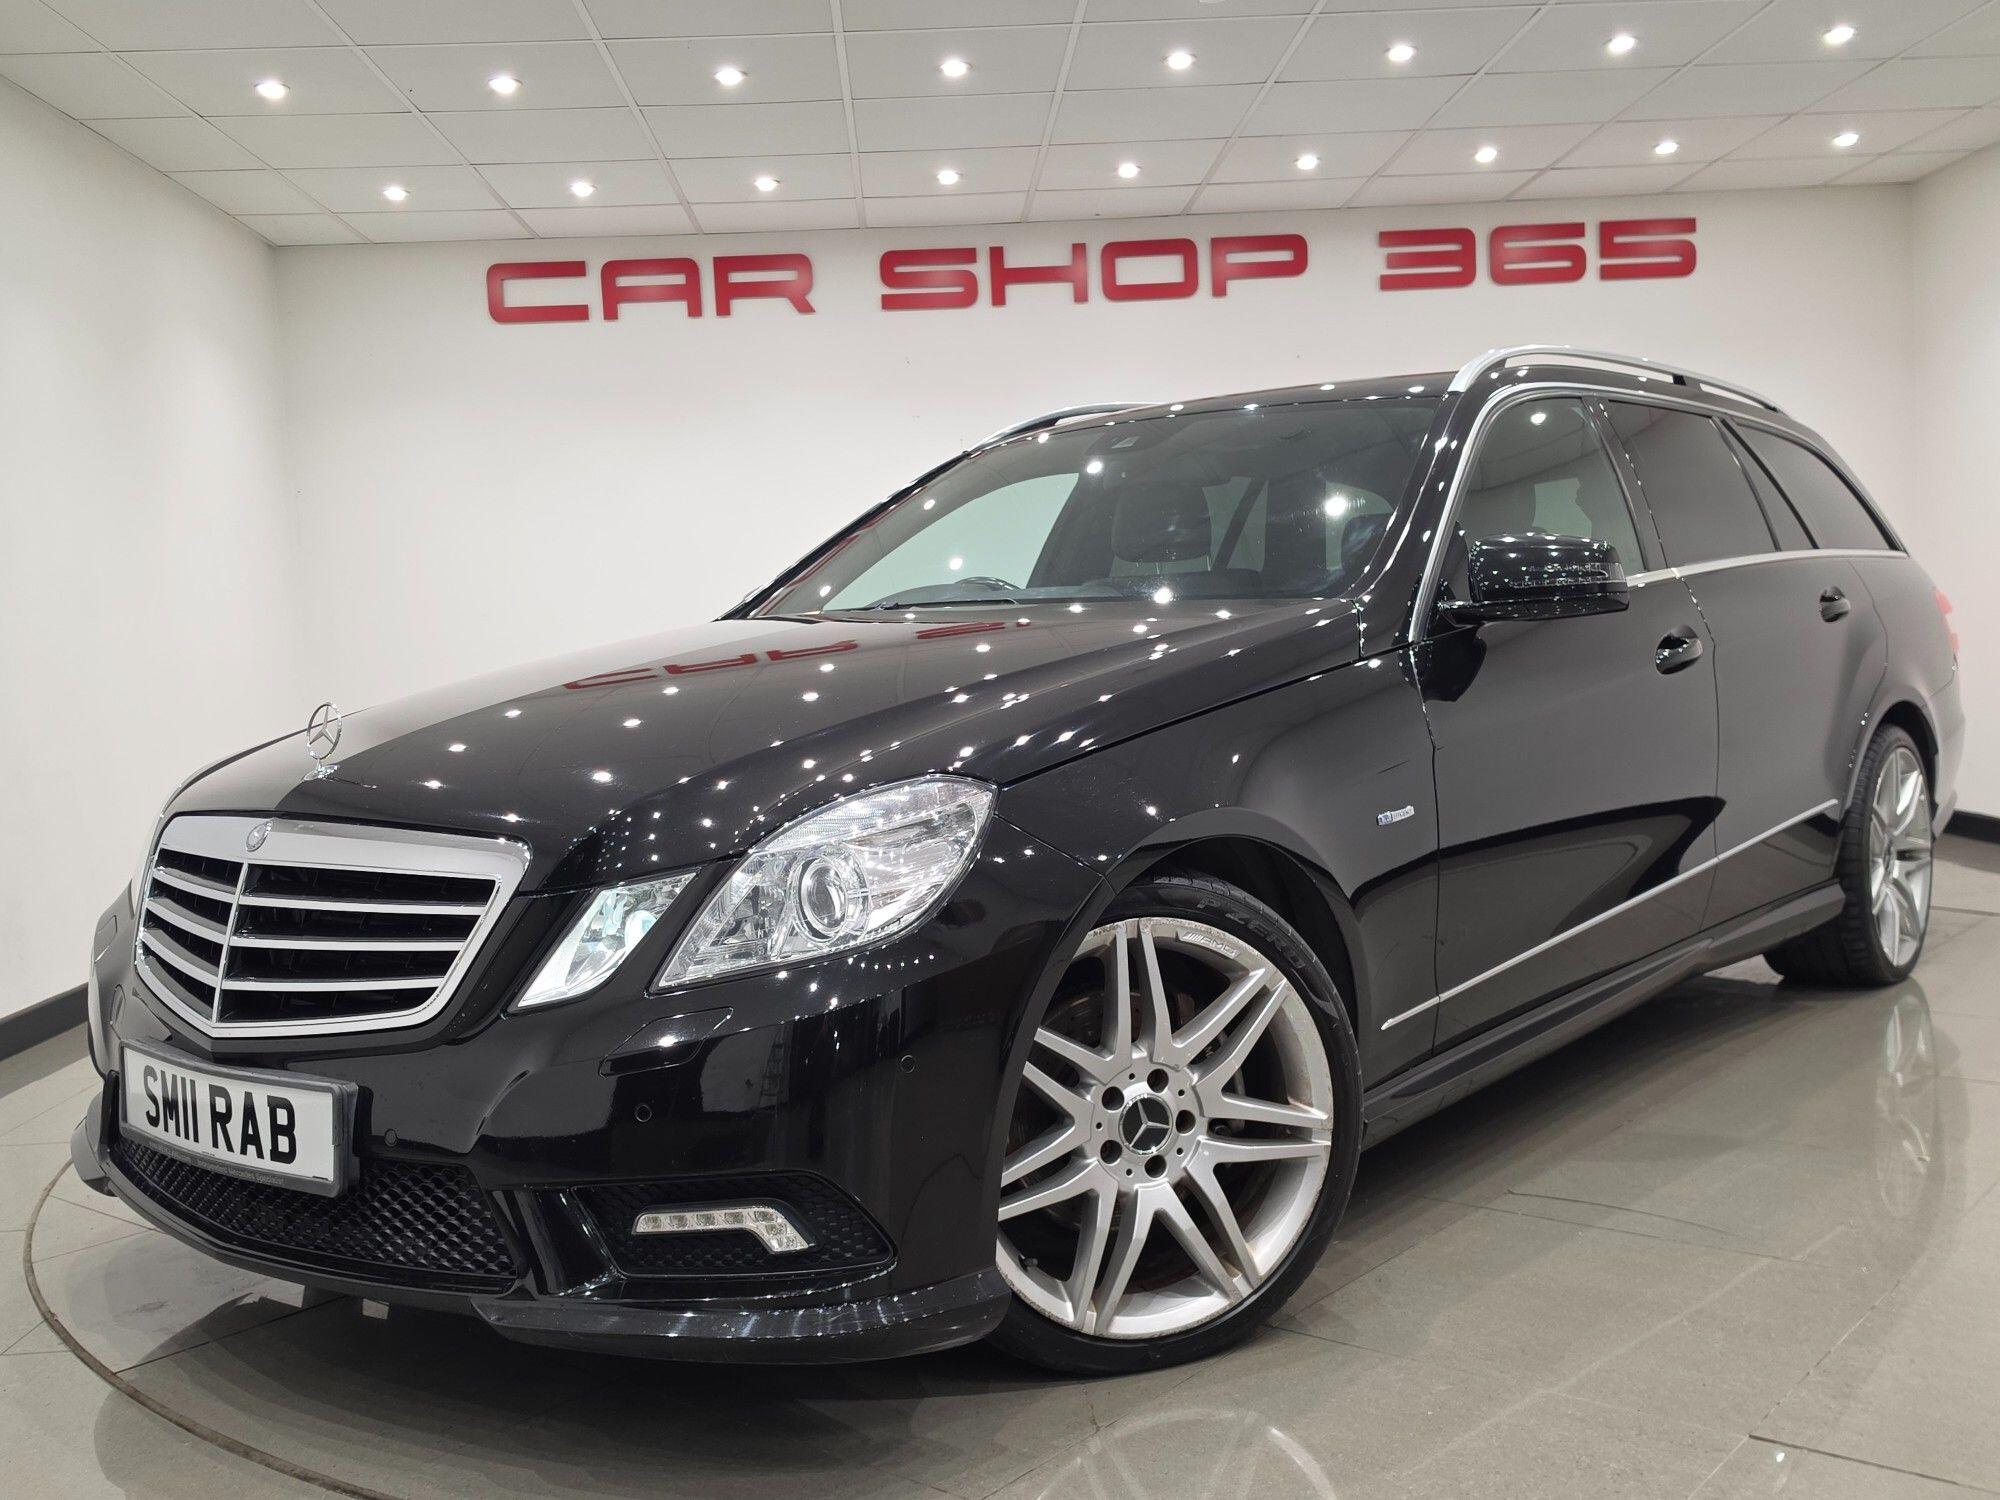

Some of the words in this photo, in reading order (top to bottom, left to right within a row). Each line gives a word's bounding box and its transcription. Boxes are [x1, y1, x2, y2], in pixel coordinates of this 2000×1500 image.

[487, 253, 815, 324] CAR
[879, 234, 1309, 311] SHOP
[1379, 217, 1697, 291] 365
[143, 1064, 200, 1144] SM11
[208, 1083, 297, 1165] RAB
